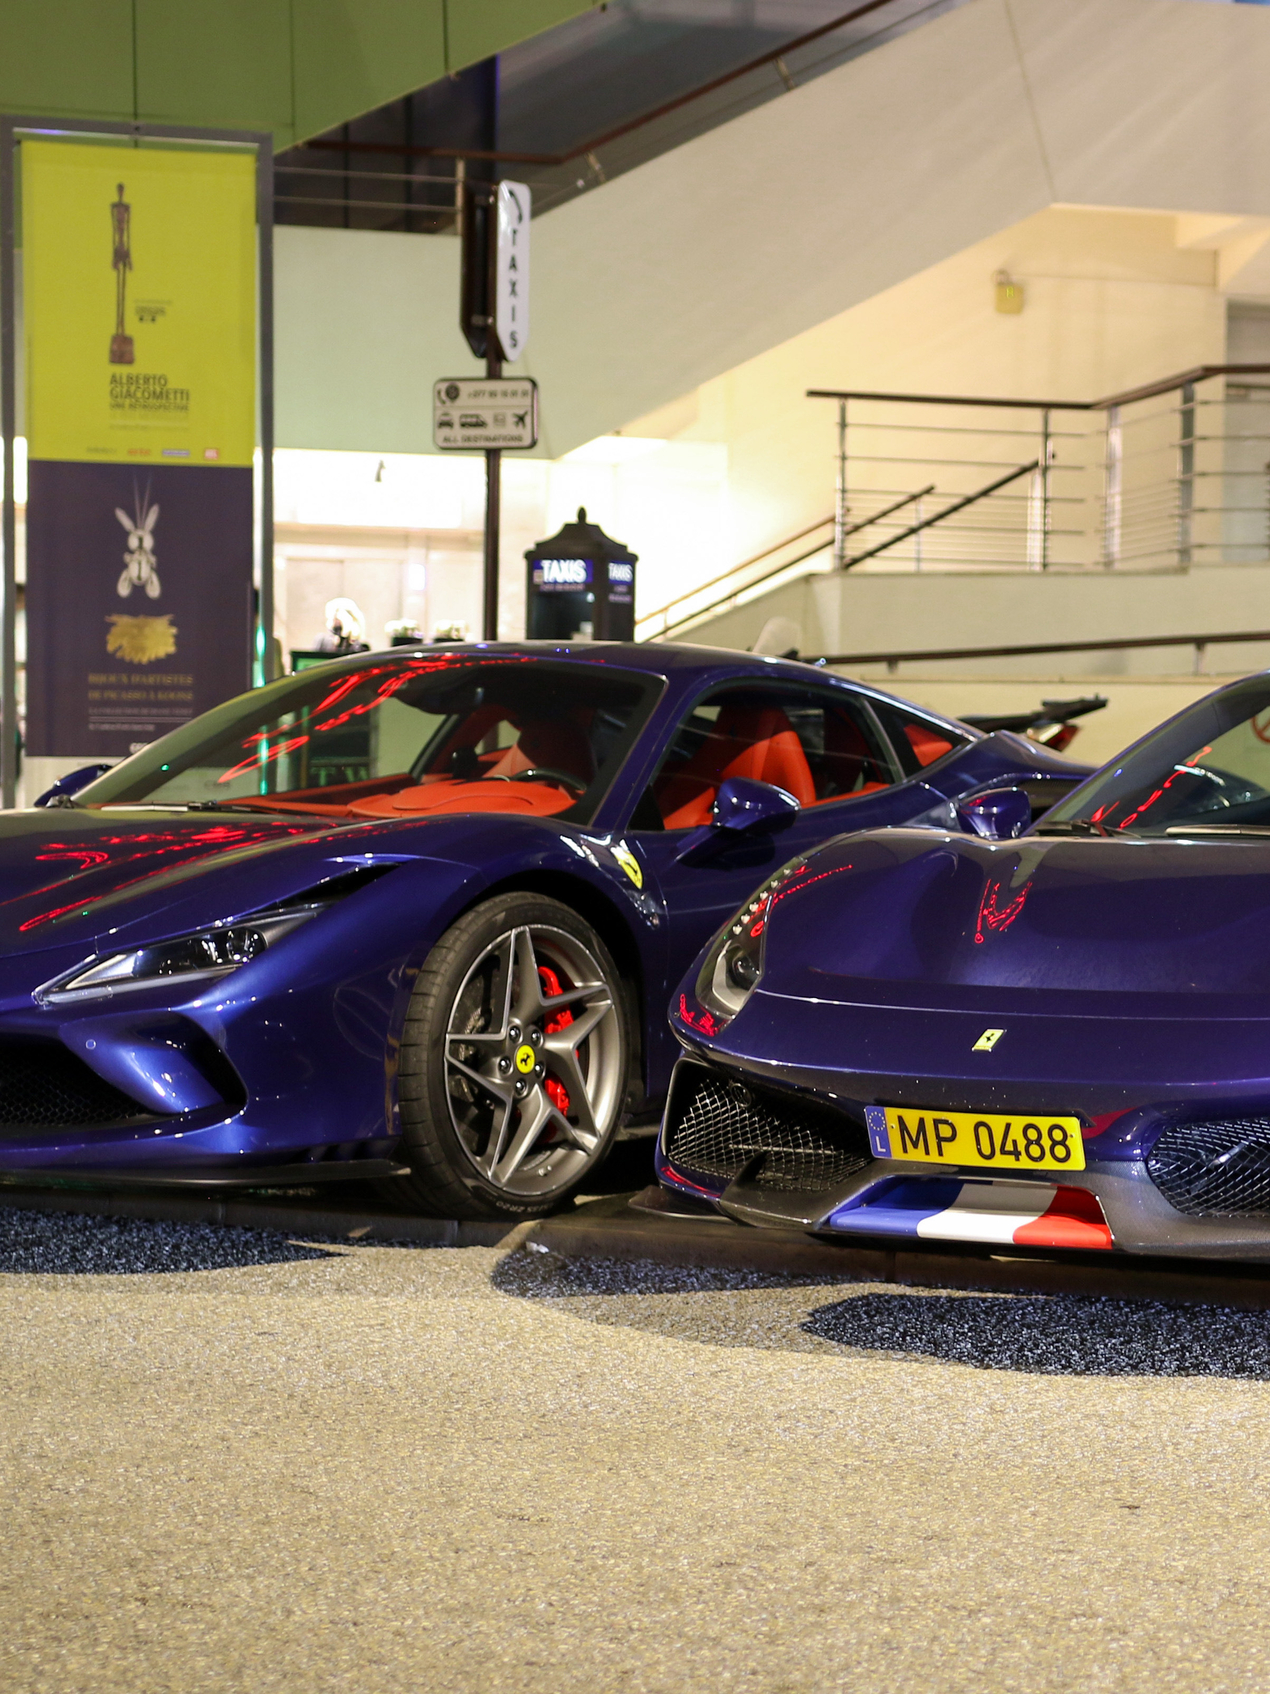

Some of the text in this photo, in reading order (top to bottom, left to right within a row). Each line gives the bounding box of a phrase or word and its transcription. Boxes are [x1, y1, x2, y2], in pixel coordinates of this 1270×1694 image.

[508, 227, 519, 349] TAXIS
[109, 372, 168, 387] ALBERTO
[109, 386, 190, 401] GIACOMETTI
[541, 559, 588, 584] TAXIS
[607, 562, 634, 582] TAXIS
[875, 1136, 887, 1153] L
[897, 1114, 1071, 1164] MP 0488
